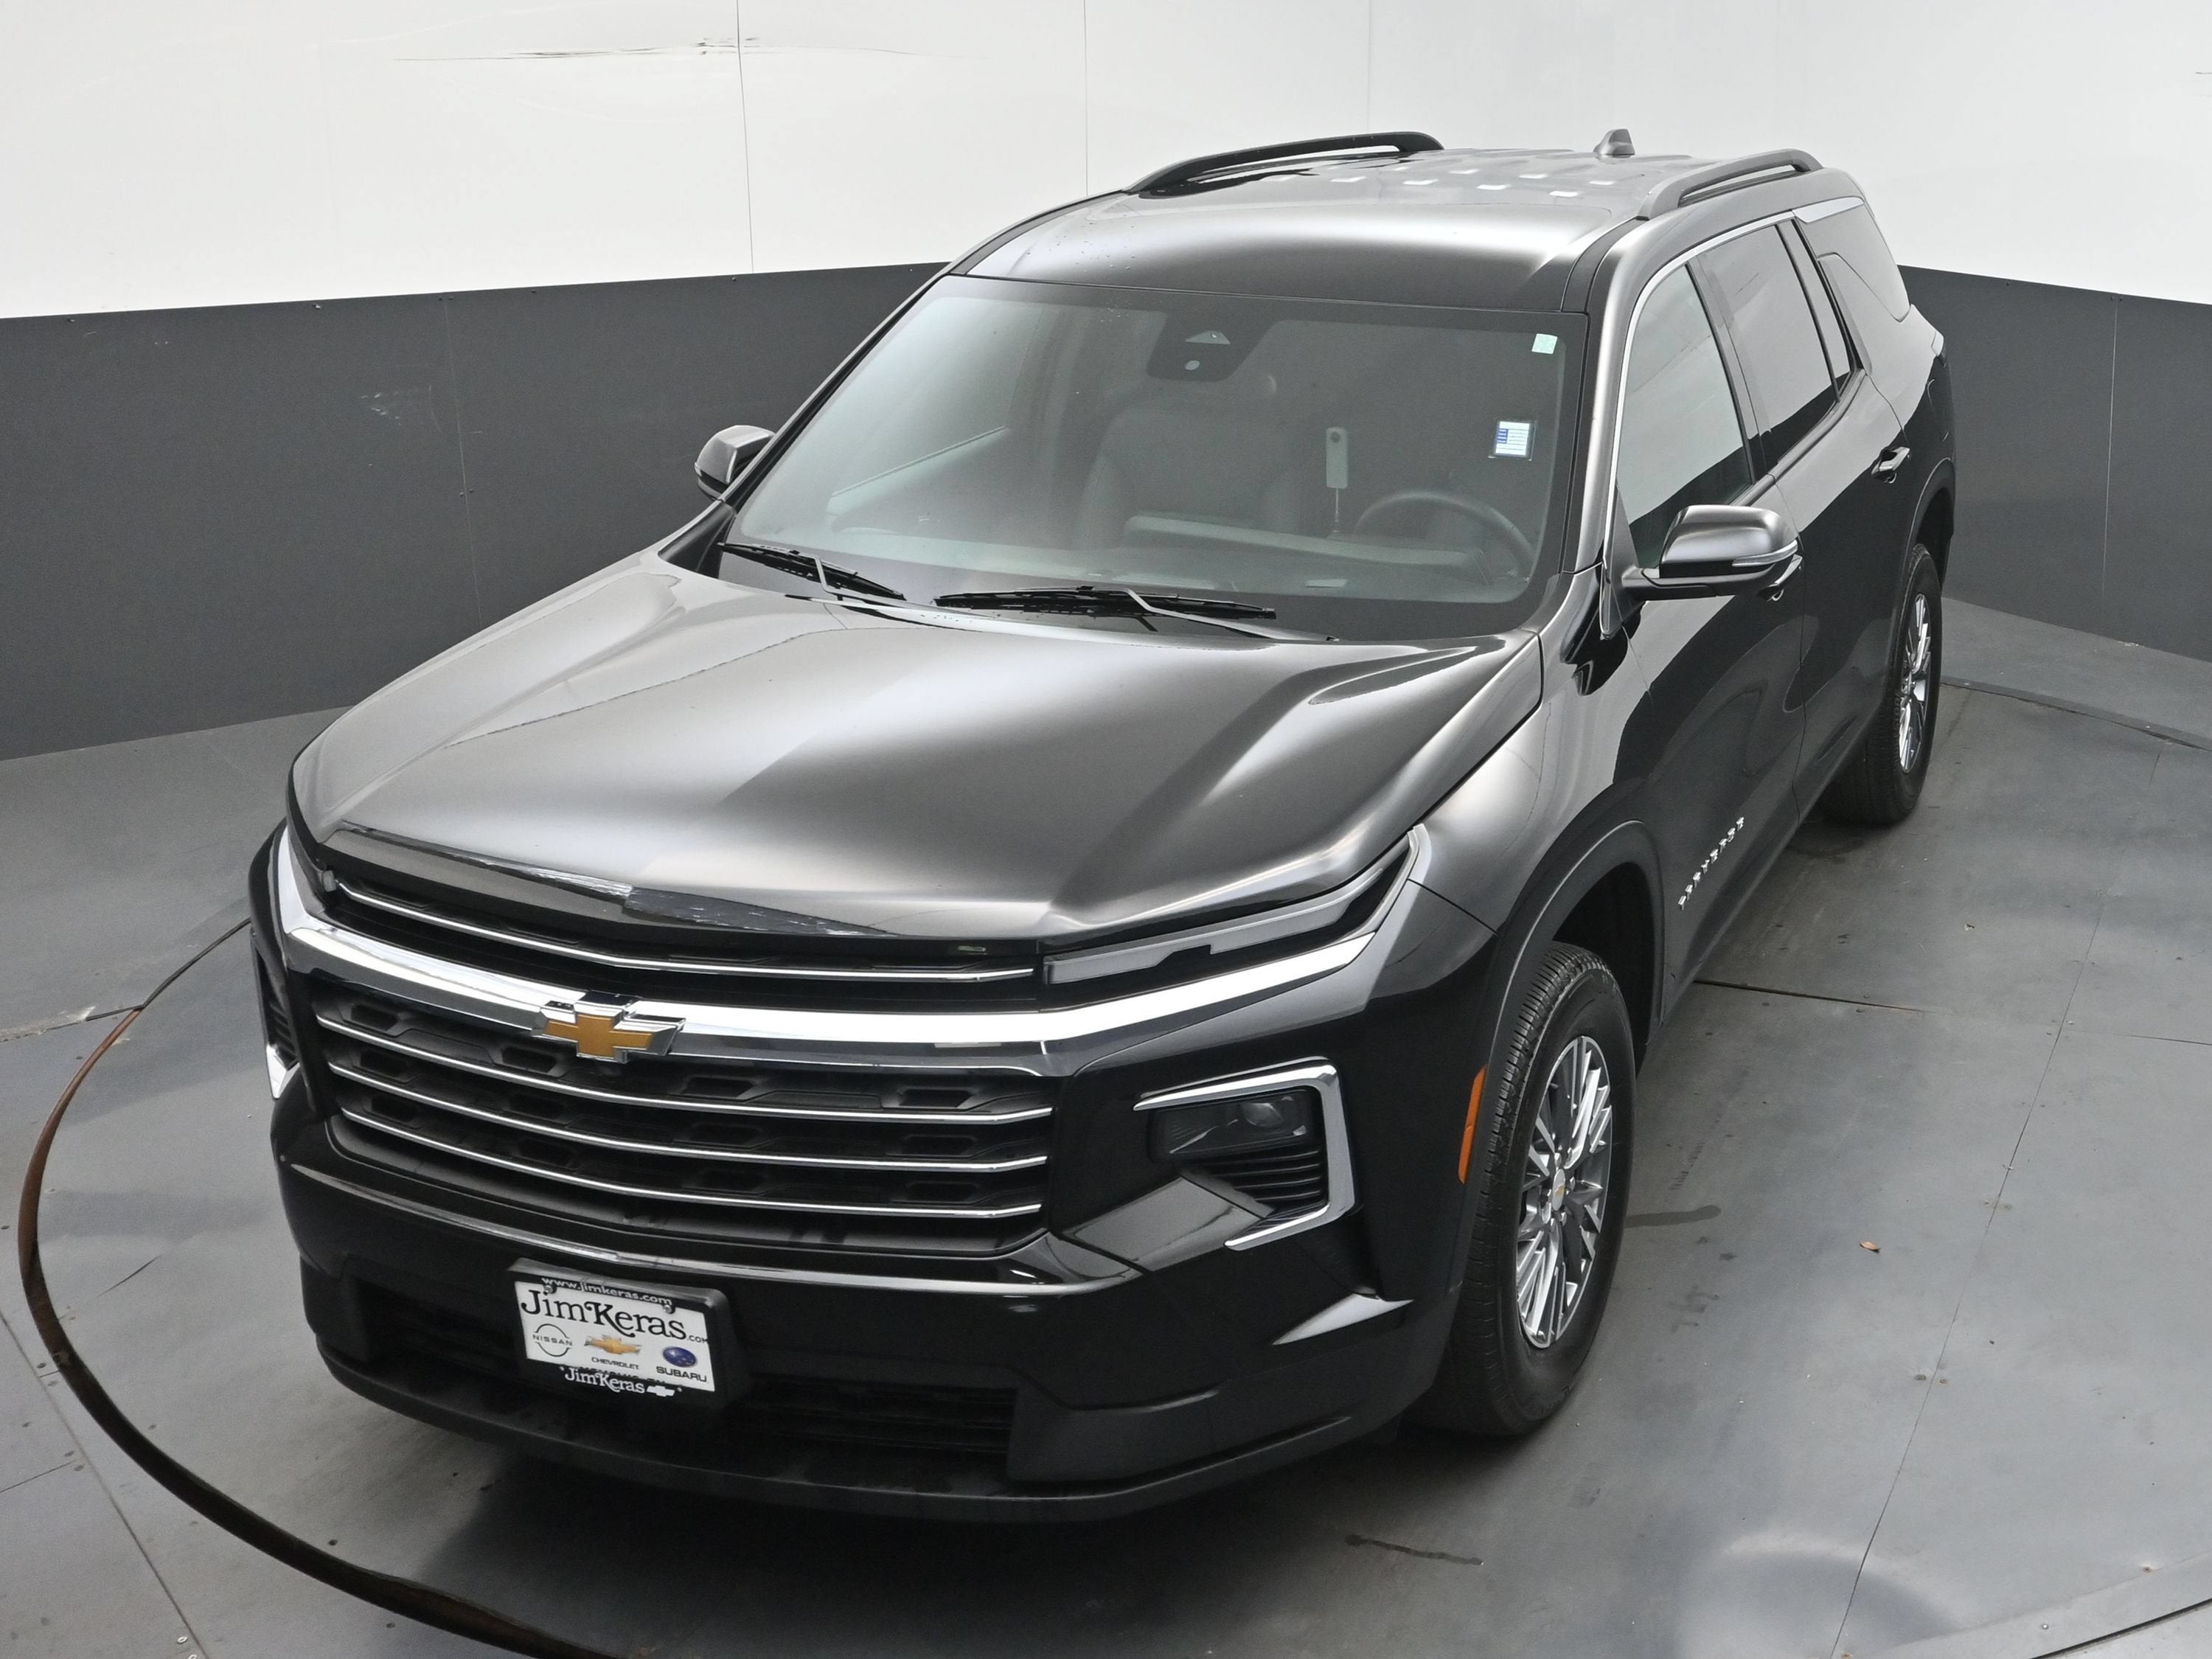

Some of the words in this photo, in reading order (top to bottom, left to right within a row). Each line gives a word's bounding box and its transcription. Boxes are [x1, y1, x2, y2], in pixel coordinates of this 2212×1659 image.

[541, 1277, 672, 1306] www.jimkeras.com
[532, 1334, 573, 1346] NISSAN
[591, 1357, 640, 1370] CHEVROLET
[655, 1366, 707, 1382] SUBARU
